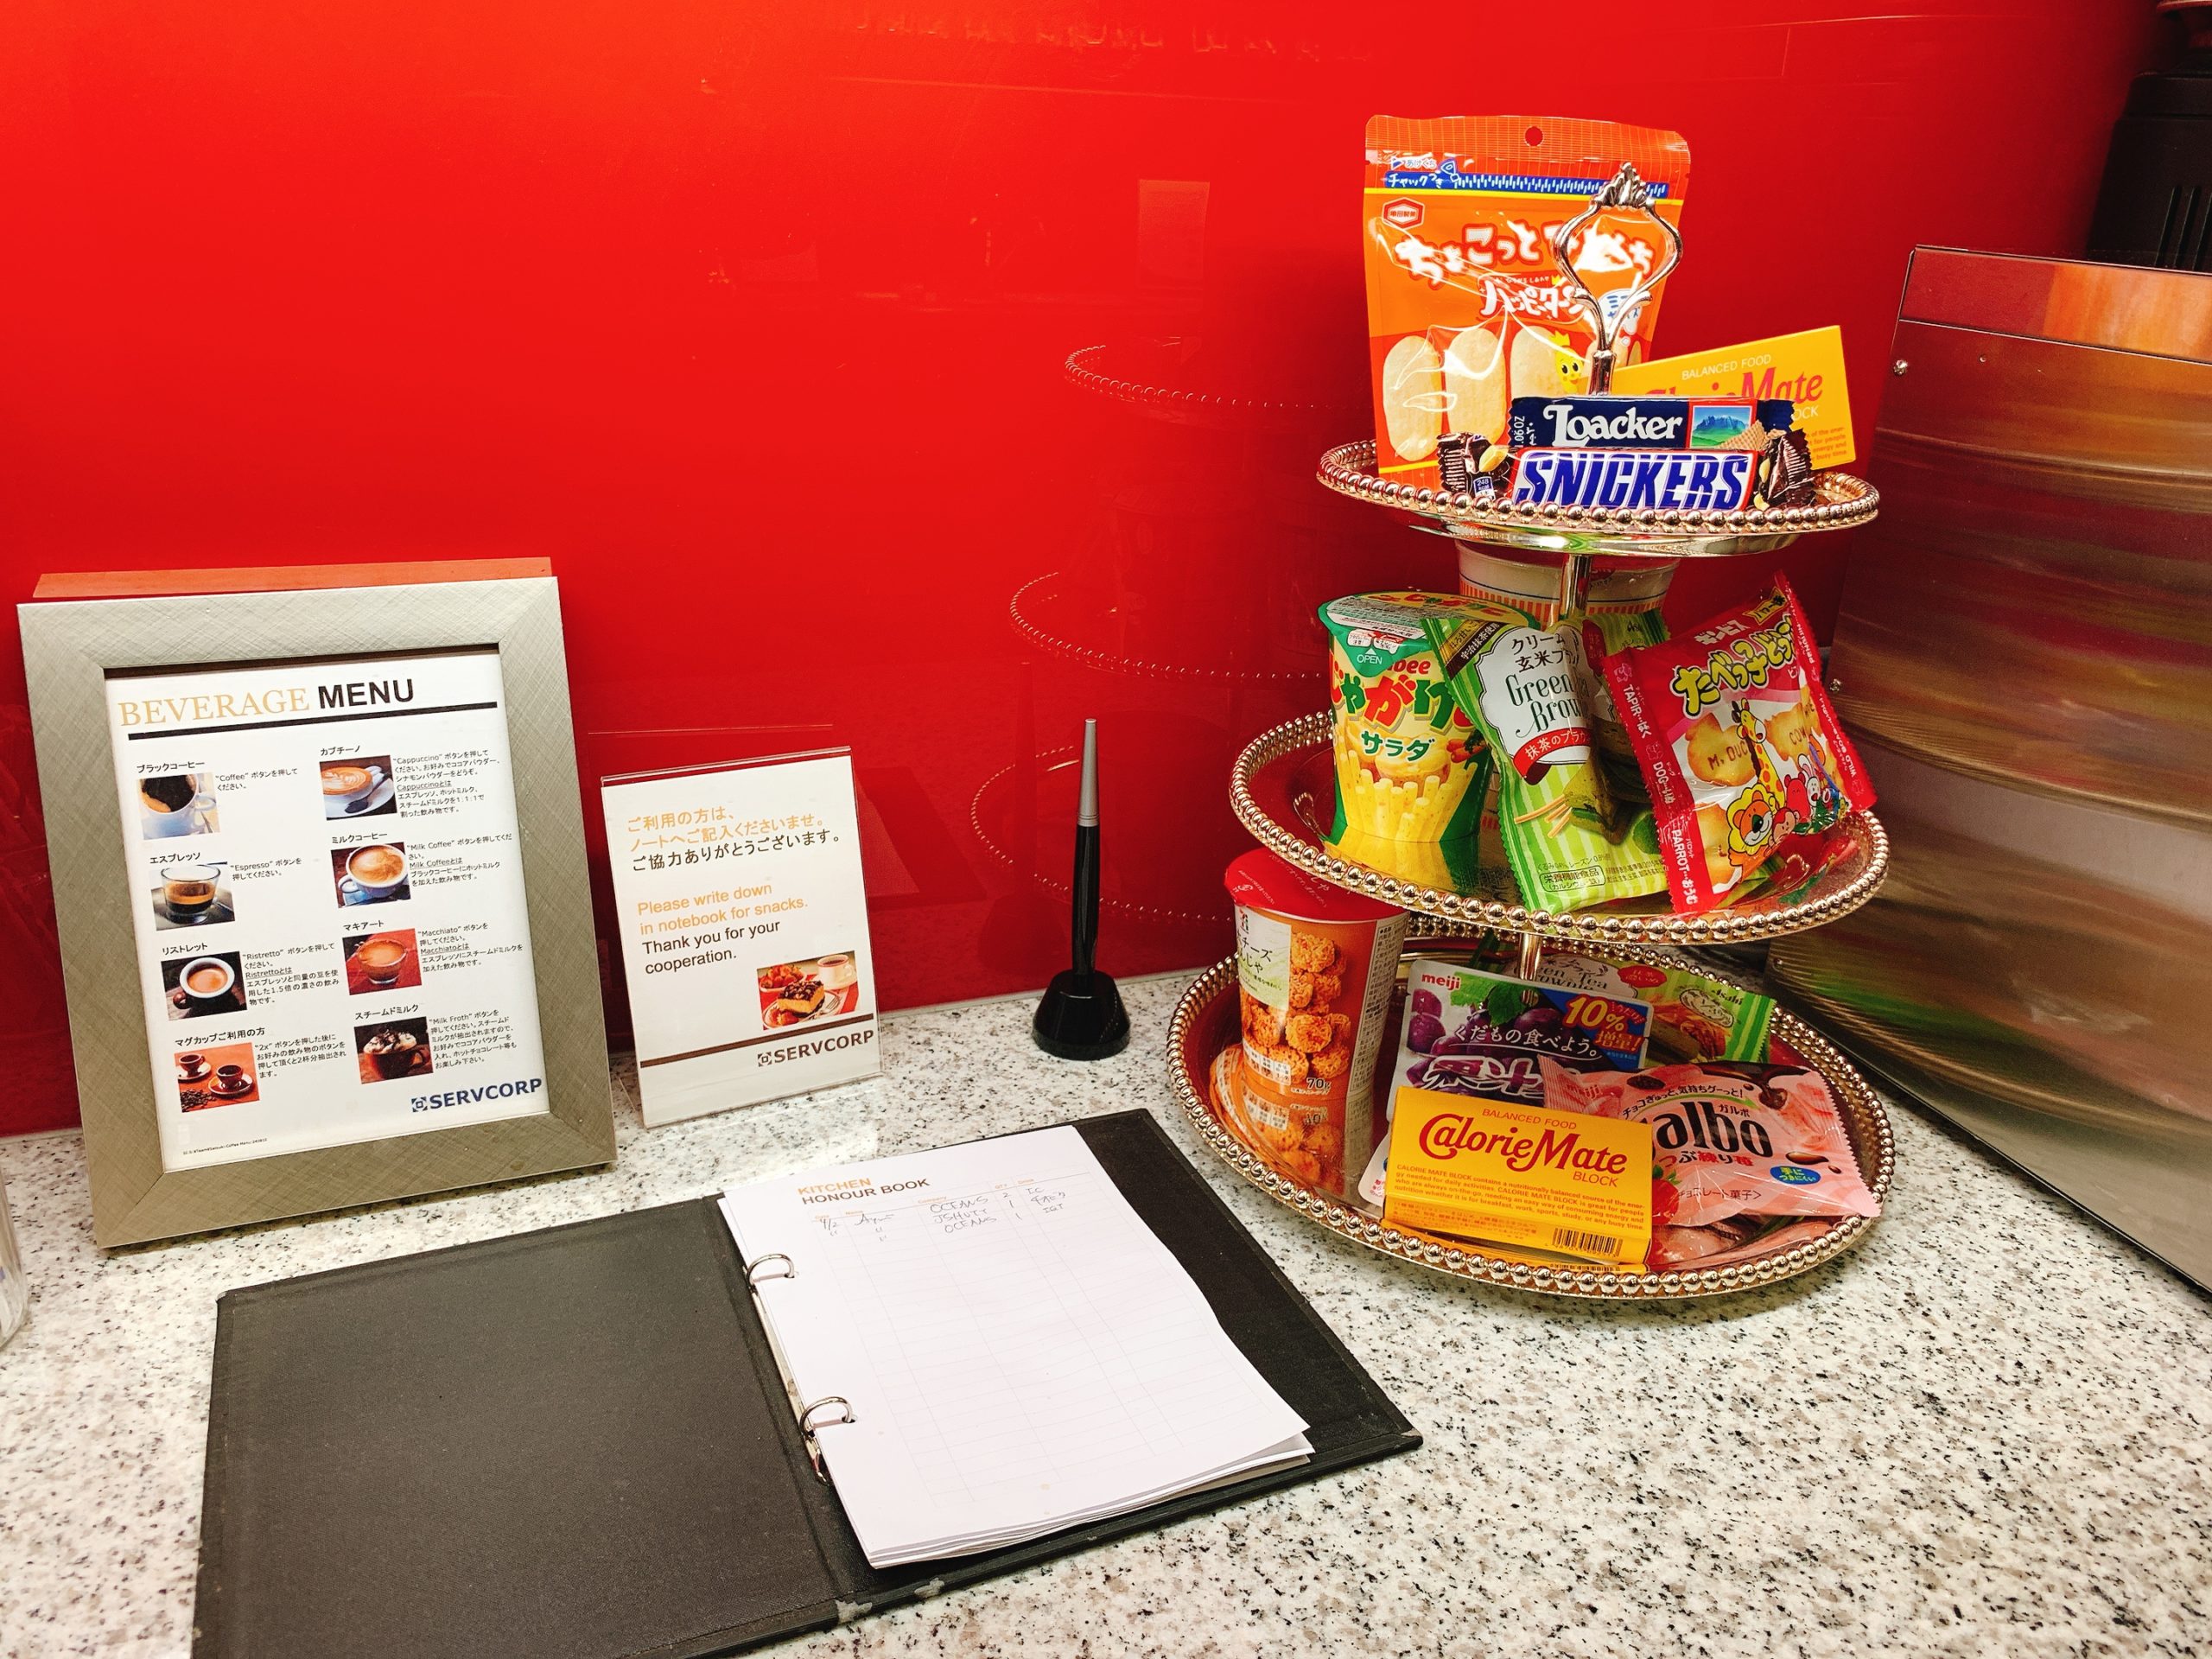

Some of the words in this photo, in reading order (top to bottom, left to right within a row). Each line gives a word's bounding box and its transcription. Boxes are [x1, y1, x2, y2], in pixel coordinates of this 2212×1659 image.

[1681, 361, 1738, 380] BALANCED
[1741, 354, 1772, 369] FOOD
[1543, 404, 1684, 447] Loacker
[1516, 452, 1748, 510] SNICKERS
[1357, 655, 1382, 664] OPEN
[117, 688, 310, 727] BEVERAGE
[318, 678, 415, 709] MENU
[1361, 730, 1435, 762] サラダ
[1789, 726, 1807, 746] COW
[136, 760, 205, 774] ブラックコーヒー
[217, 783, 247, 791] ください。
[628, 806, 734, 831] ご利用の方は、
[332, 832, 388, 844] ミルクコーヒー
[630, 814, 824, 852] ノートへご記入くださいませ。
[149, 852, 200, 864] エスプレッソ
[633, 829, 840, 871] ご協力ありがとうございます。
[637, 898, 690, 917] Please
[694, 891, 730, 907] write
[734, 883, 772, 899] down
[343, 919, 385, 931] マキアート
[639, 920, 654, 935] in
[658, 909, 727, 933] notebook
[730, 906, 751, 922] for
[754, 896, 809, 917] snacks.
[162, 942, 208, 956] リストレット
[643, 936, 690, 955] Thank
[694, 931, 721, 950] you
[725, 926, 744, 942] for
[749, 920, 780, 942] your
[645, 946, 737, 976] cooperation.
[1421, 971, 1461, 991] meiji
[355, 1003, 419, 1020] スチームドミルク
[1565, 996, 1624, 1033] 10%
[175, 1027, 265, 1047] マグカップご利用の方
[774, 1029, 874, 1064] SERVCORP
[1455, 1024, 1599, 1058] くだもの食べよう。
[429, 1078, 543, 1109] SERVCORP
[1482, 1108, 1541, 1124] BALANCED
[1545, 1118, 1577, 1130] FOOD
[1718, 1103, 1751, 1118] ガルボ
[1643, 1101, 1774, 1160] albo
[1419, 1113, 1628, 1175] CalorieMate
[798, 1178, 872, 1195] KITCHEN
[802, 1188, 877, 1205] HONOUR
[880, 1178, 931, 1194] BOOK
[1573, 1171, 1618, 1187] BLOCK
